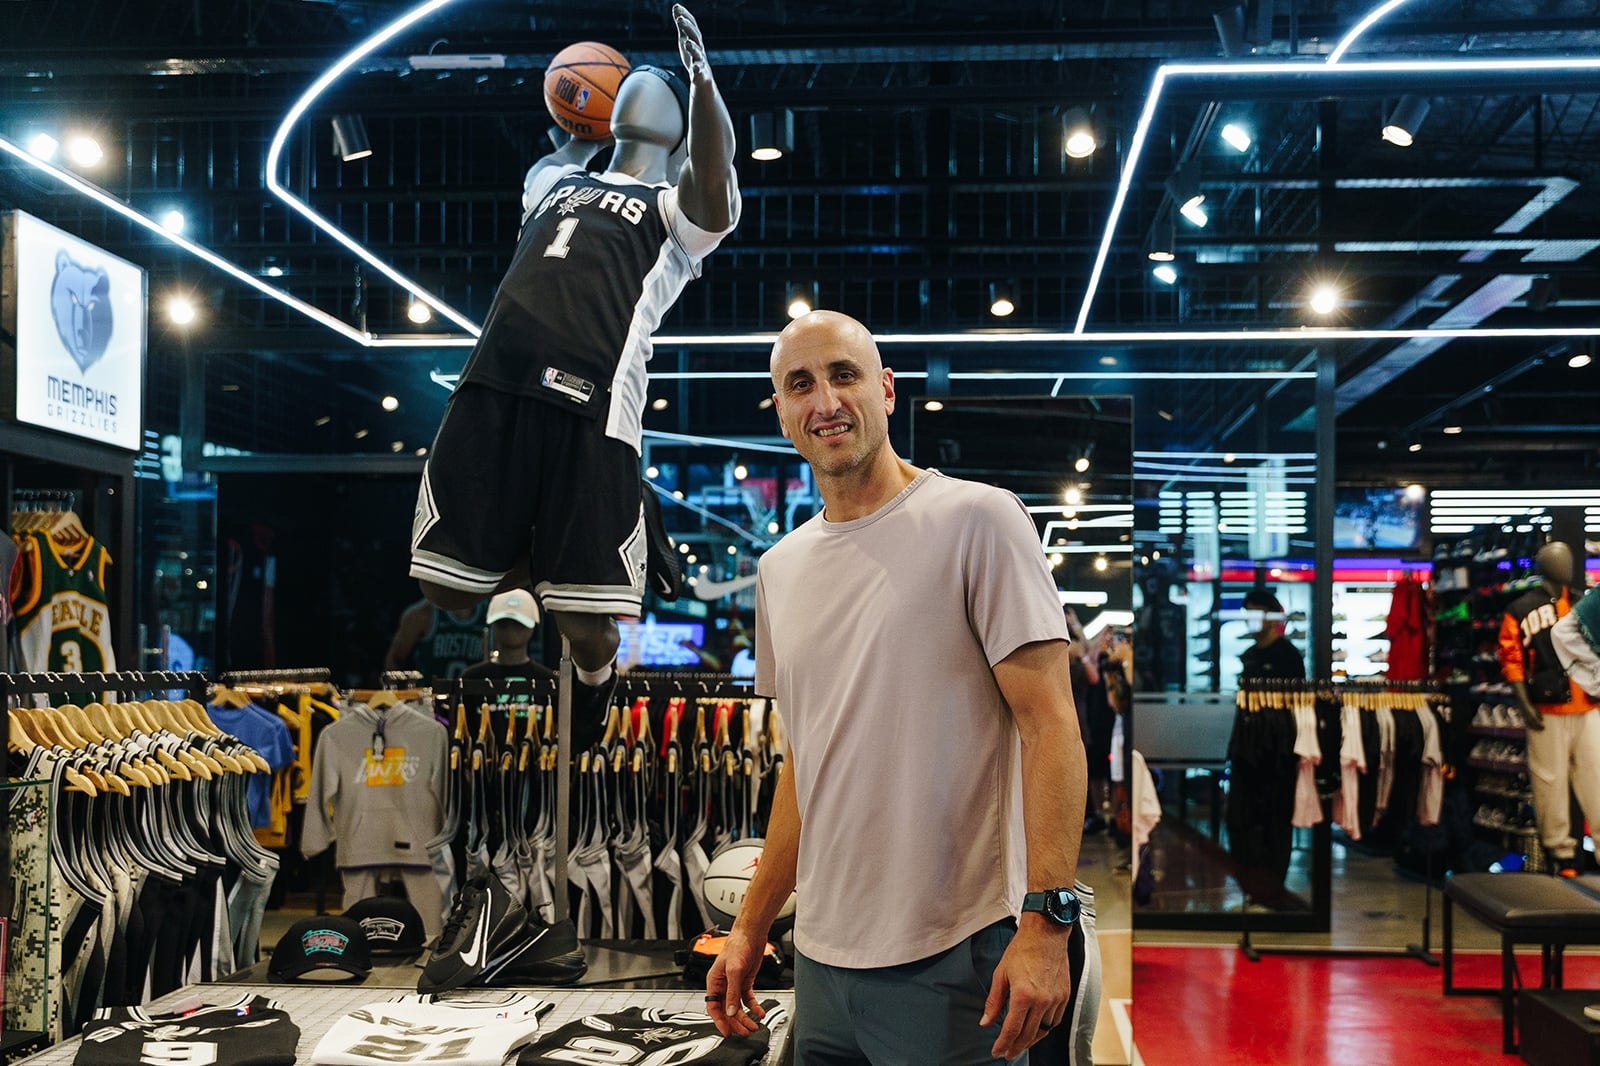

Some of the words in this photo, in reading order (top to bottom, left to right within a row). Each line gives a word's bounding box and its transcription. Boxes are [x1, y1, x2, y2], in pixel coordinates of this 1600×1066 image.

[543, 216, 580, 260] 1
[47, 375, 118, 417] MEMPHIS
[47, 403, 118, 434] GRIZZLIES
[60, 640, 84, 672] 3
[345, 1034, 476, 1062] 21
